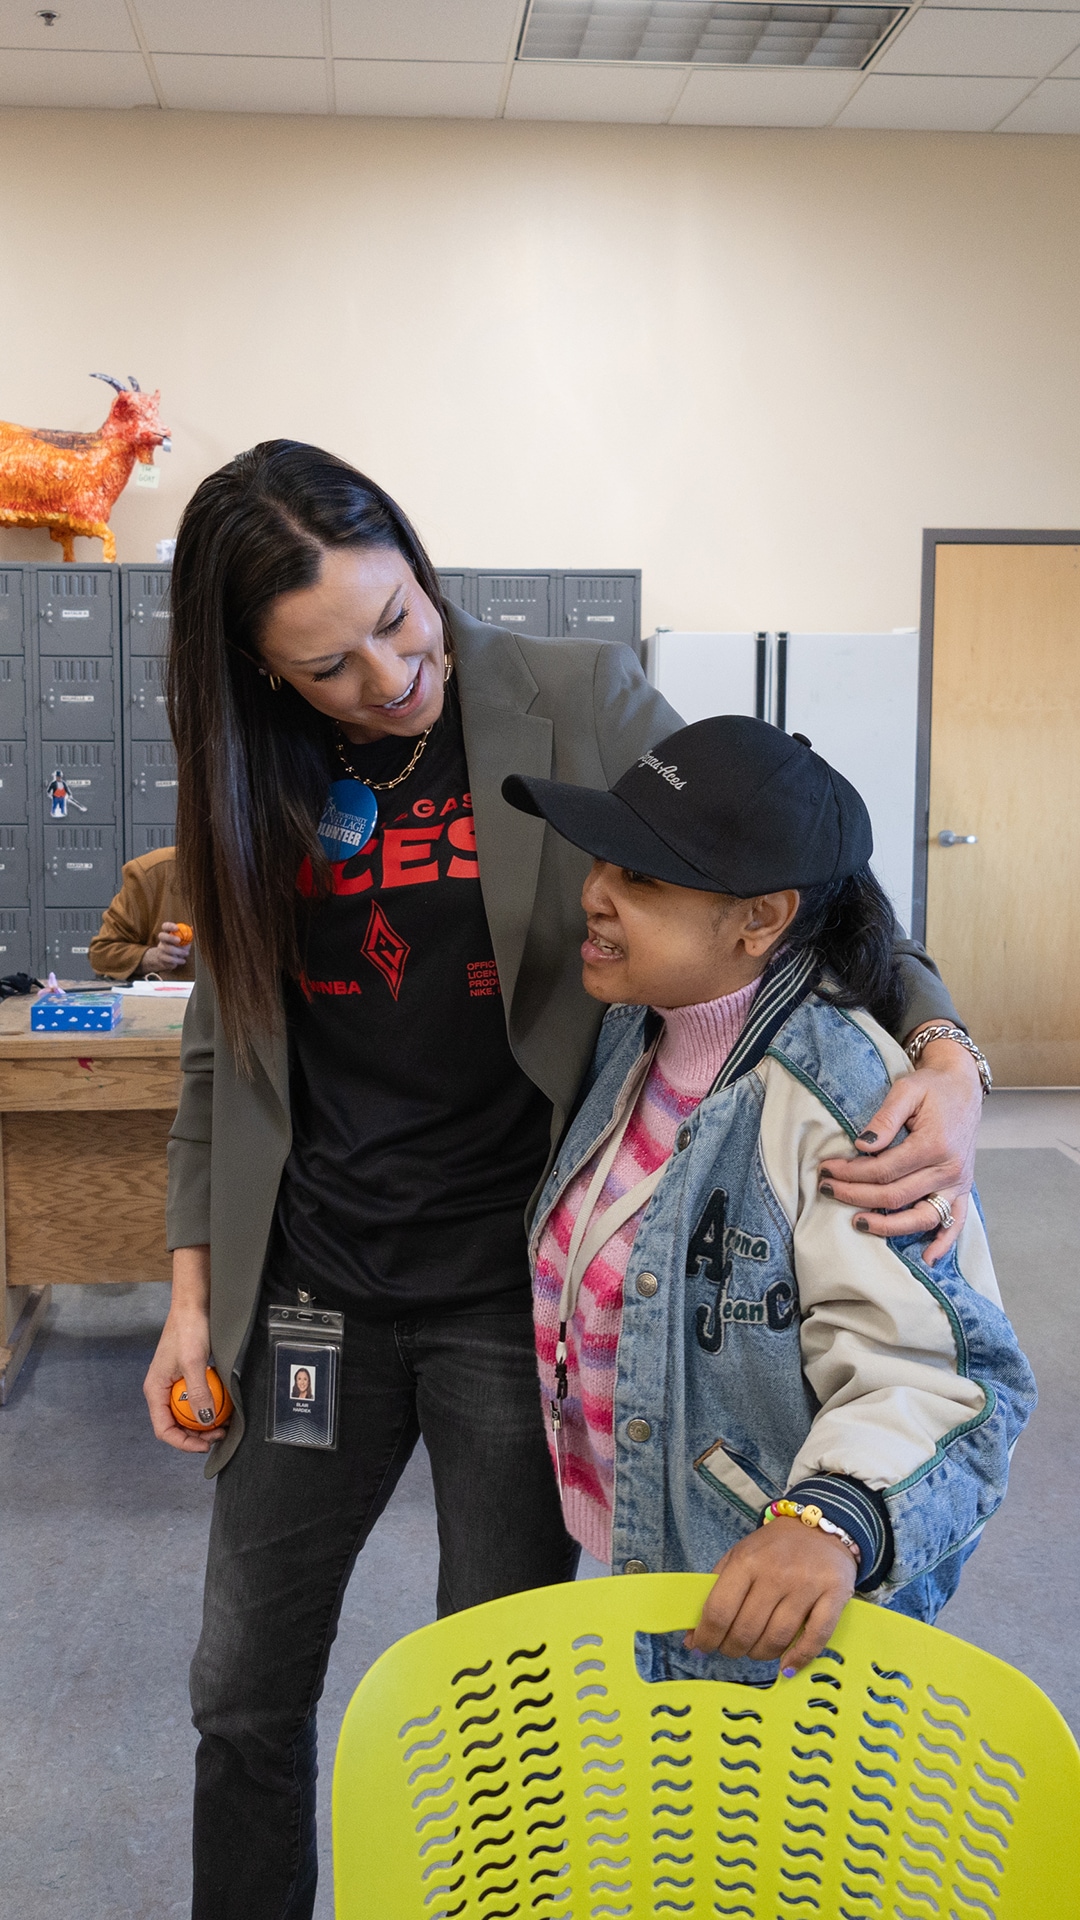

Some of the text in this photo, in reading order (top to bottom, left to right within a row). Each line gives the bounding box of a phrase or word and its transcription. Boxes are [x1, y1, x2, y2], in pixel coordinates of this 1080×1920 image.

[657, 765, 687, 790] Aces
[467, 960, 497, 970] OFFIC
[467, 970, 498, 979] LICEN
